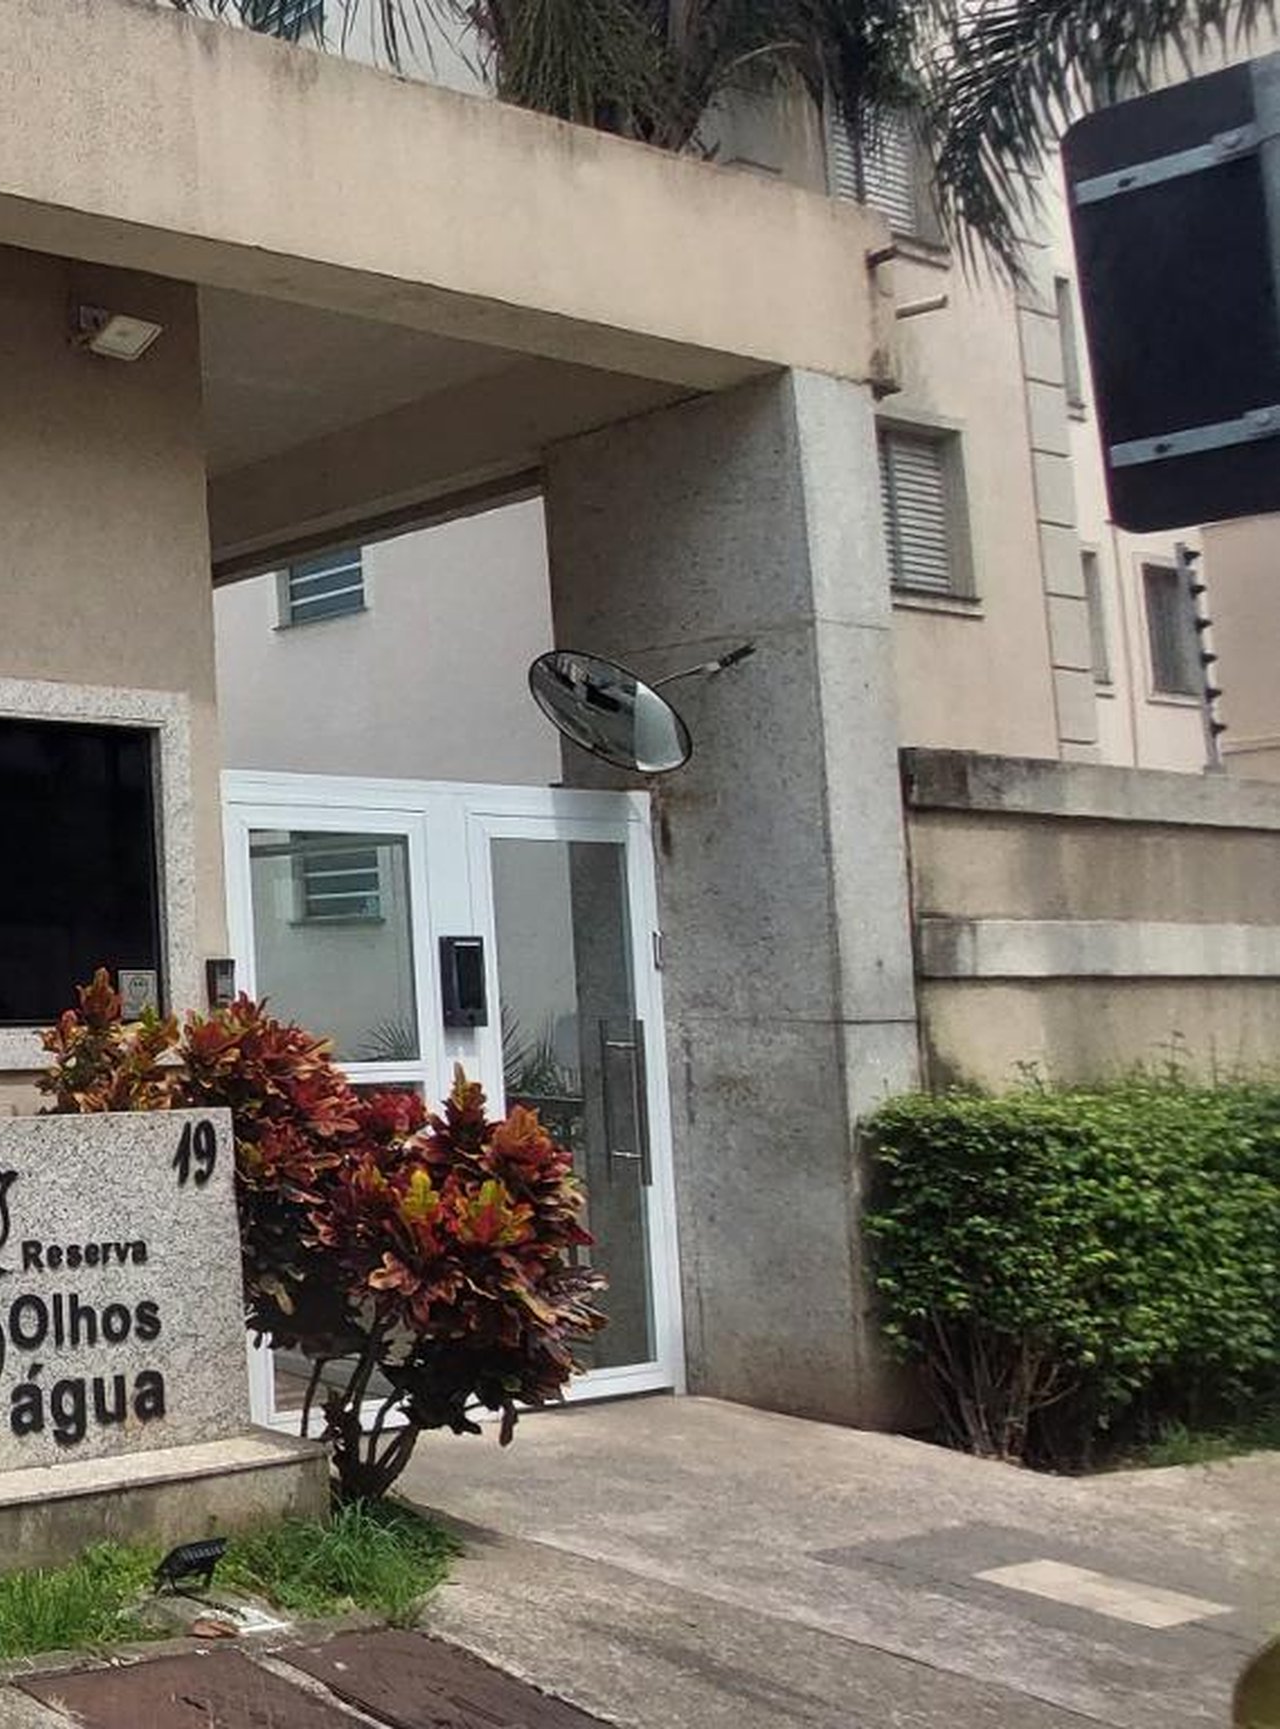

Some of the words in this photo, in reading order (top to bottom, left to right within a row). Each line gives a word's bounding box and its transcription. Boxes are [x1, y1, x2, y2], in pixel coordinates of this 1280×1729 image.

[172, 1119, 217, 1187] 19
[21, 1238, 149, 1271] Reserva
[8, 1292, 162, 1350] Olhos
